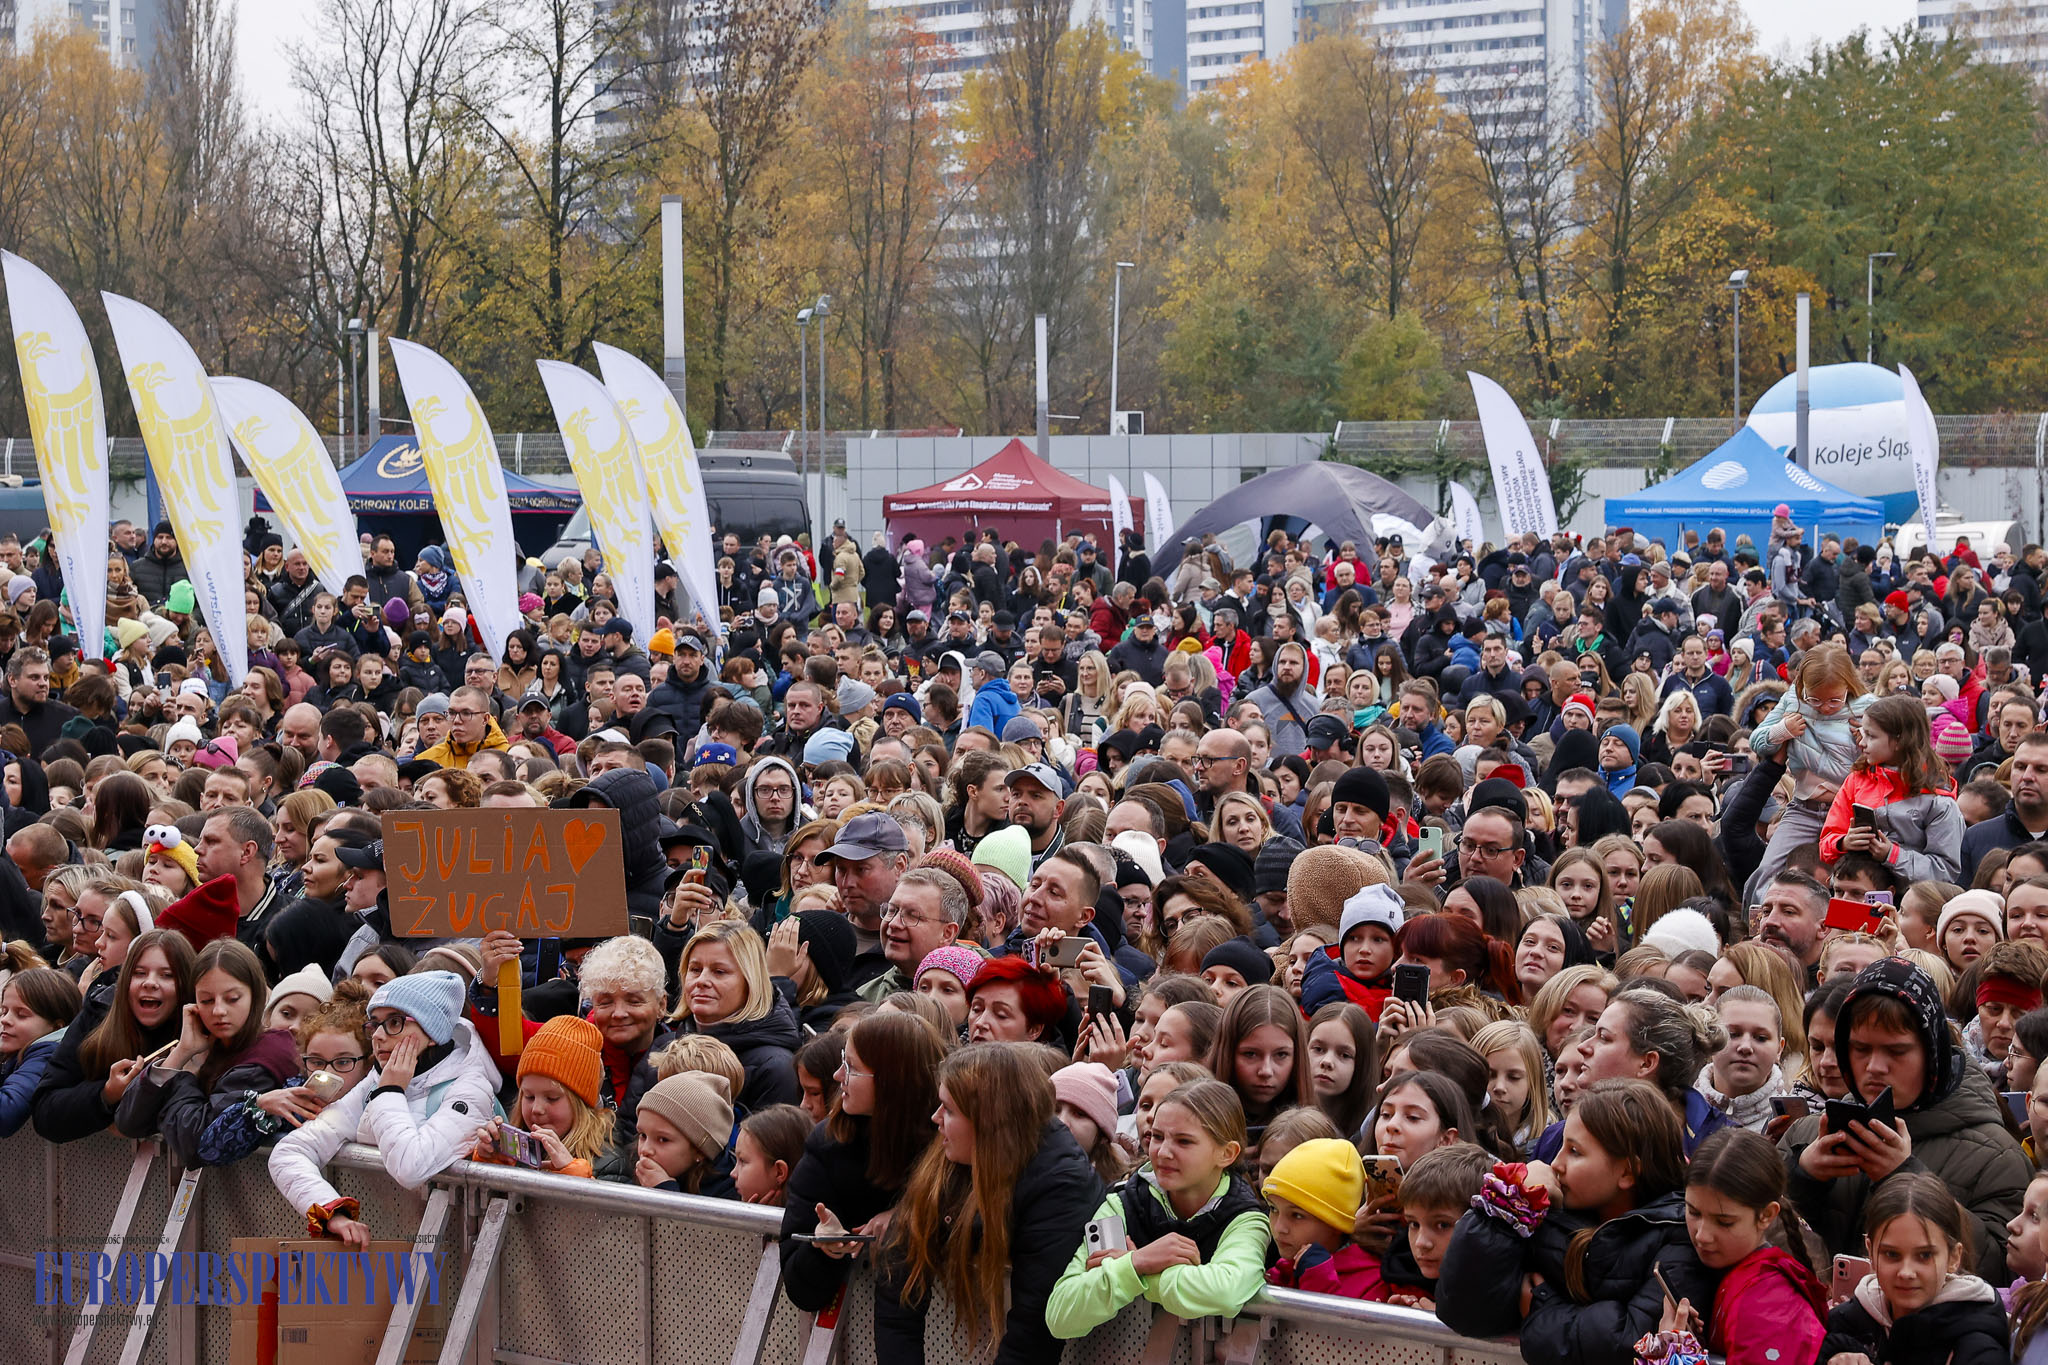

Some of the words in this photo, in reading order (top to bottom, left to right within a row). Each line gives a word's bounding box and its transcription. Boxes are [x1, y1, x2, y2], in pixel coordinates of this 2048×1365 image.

[1815, 443, 1873, 466] Koleje
[1877, 436, 1913, 461] Śląs
[399, 499, 429, 510] KOLEI
[398, 875, 576, 936] ŻUGAJ
